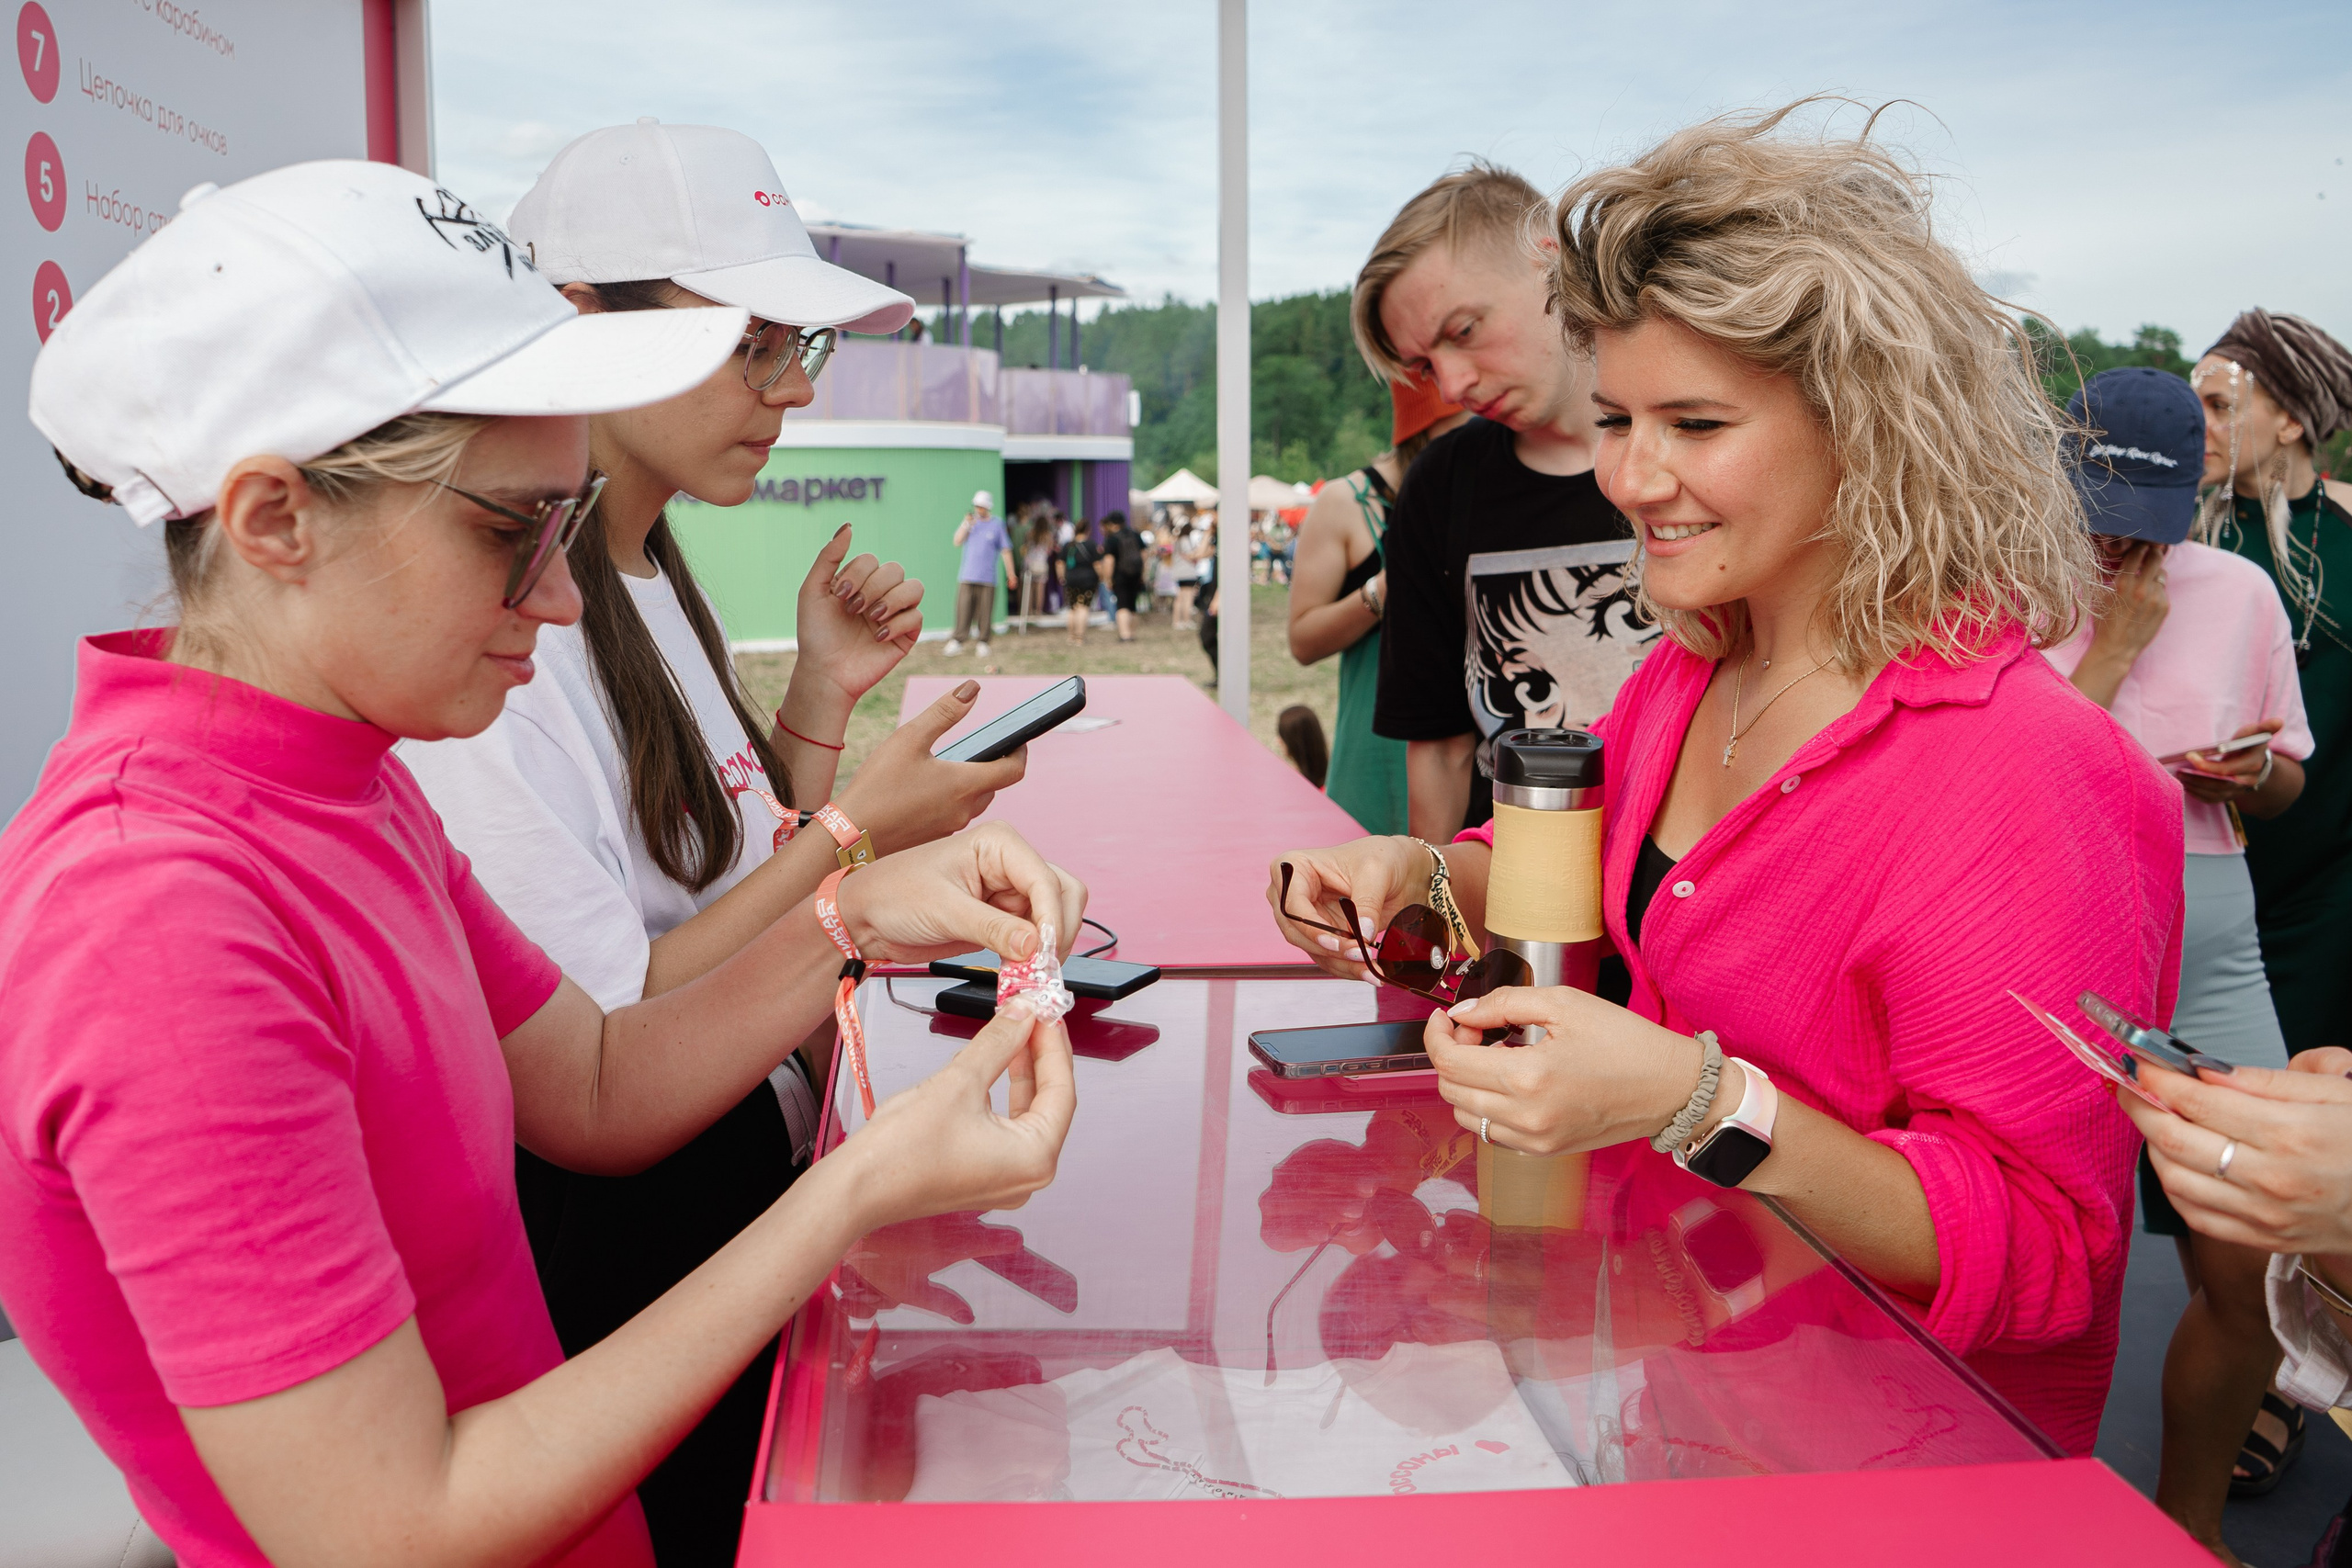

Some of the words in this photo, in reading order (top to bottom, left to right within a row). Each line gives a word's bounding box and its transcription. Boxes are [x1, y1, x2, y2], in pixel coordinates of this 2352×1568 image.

[30, 30, 46, 72] 7
[79, 57, 153, 122] Цепочка
[157, 105, 184, 136] для
[188, 120, 227, 156] очков
[40, 160, 54, 203] 5
[85, 179, 144, 238] Набор
[47, 288, 61, 330] 2
